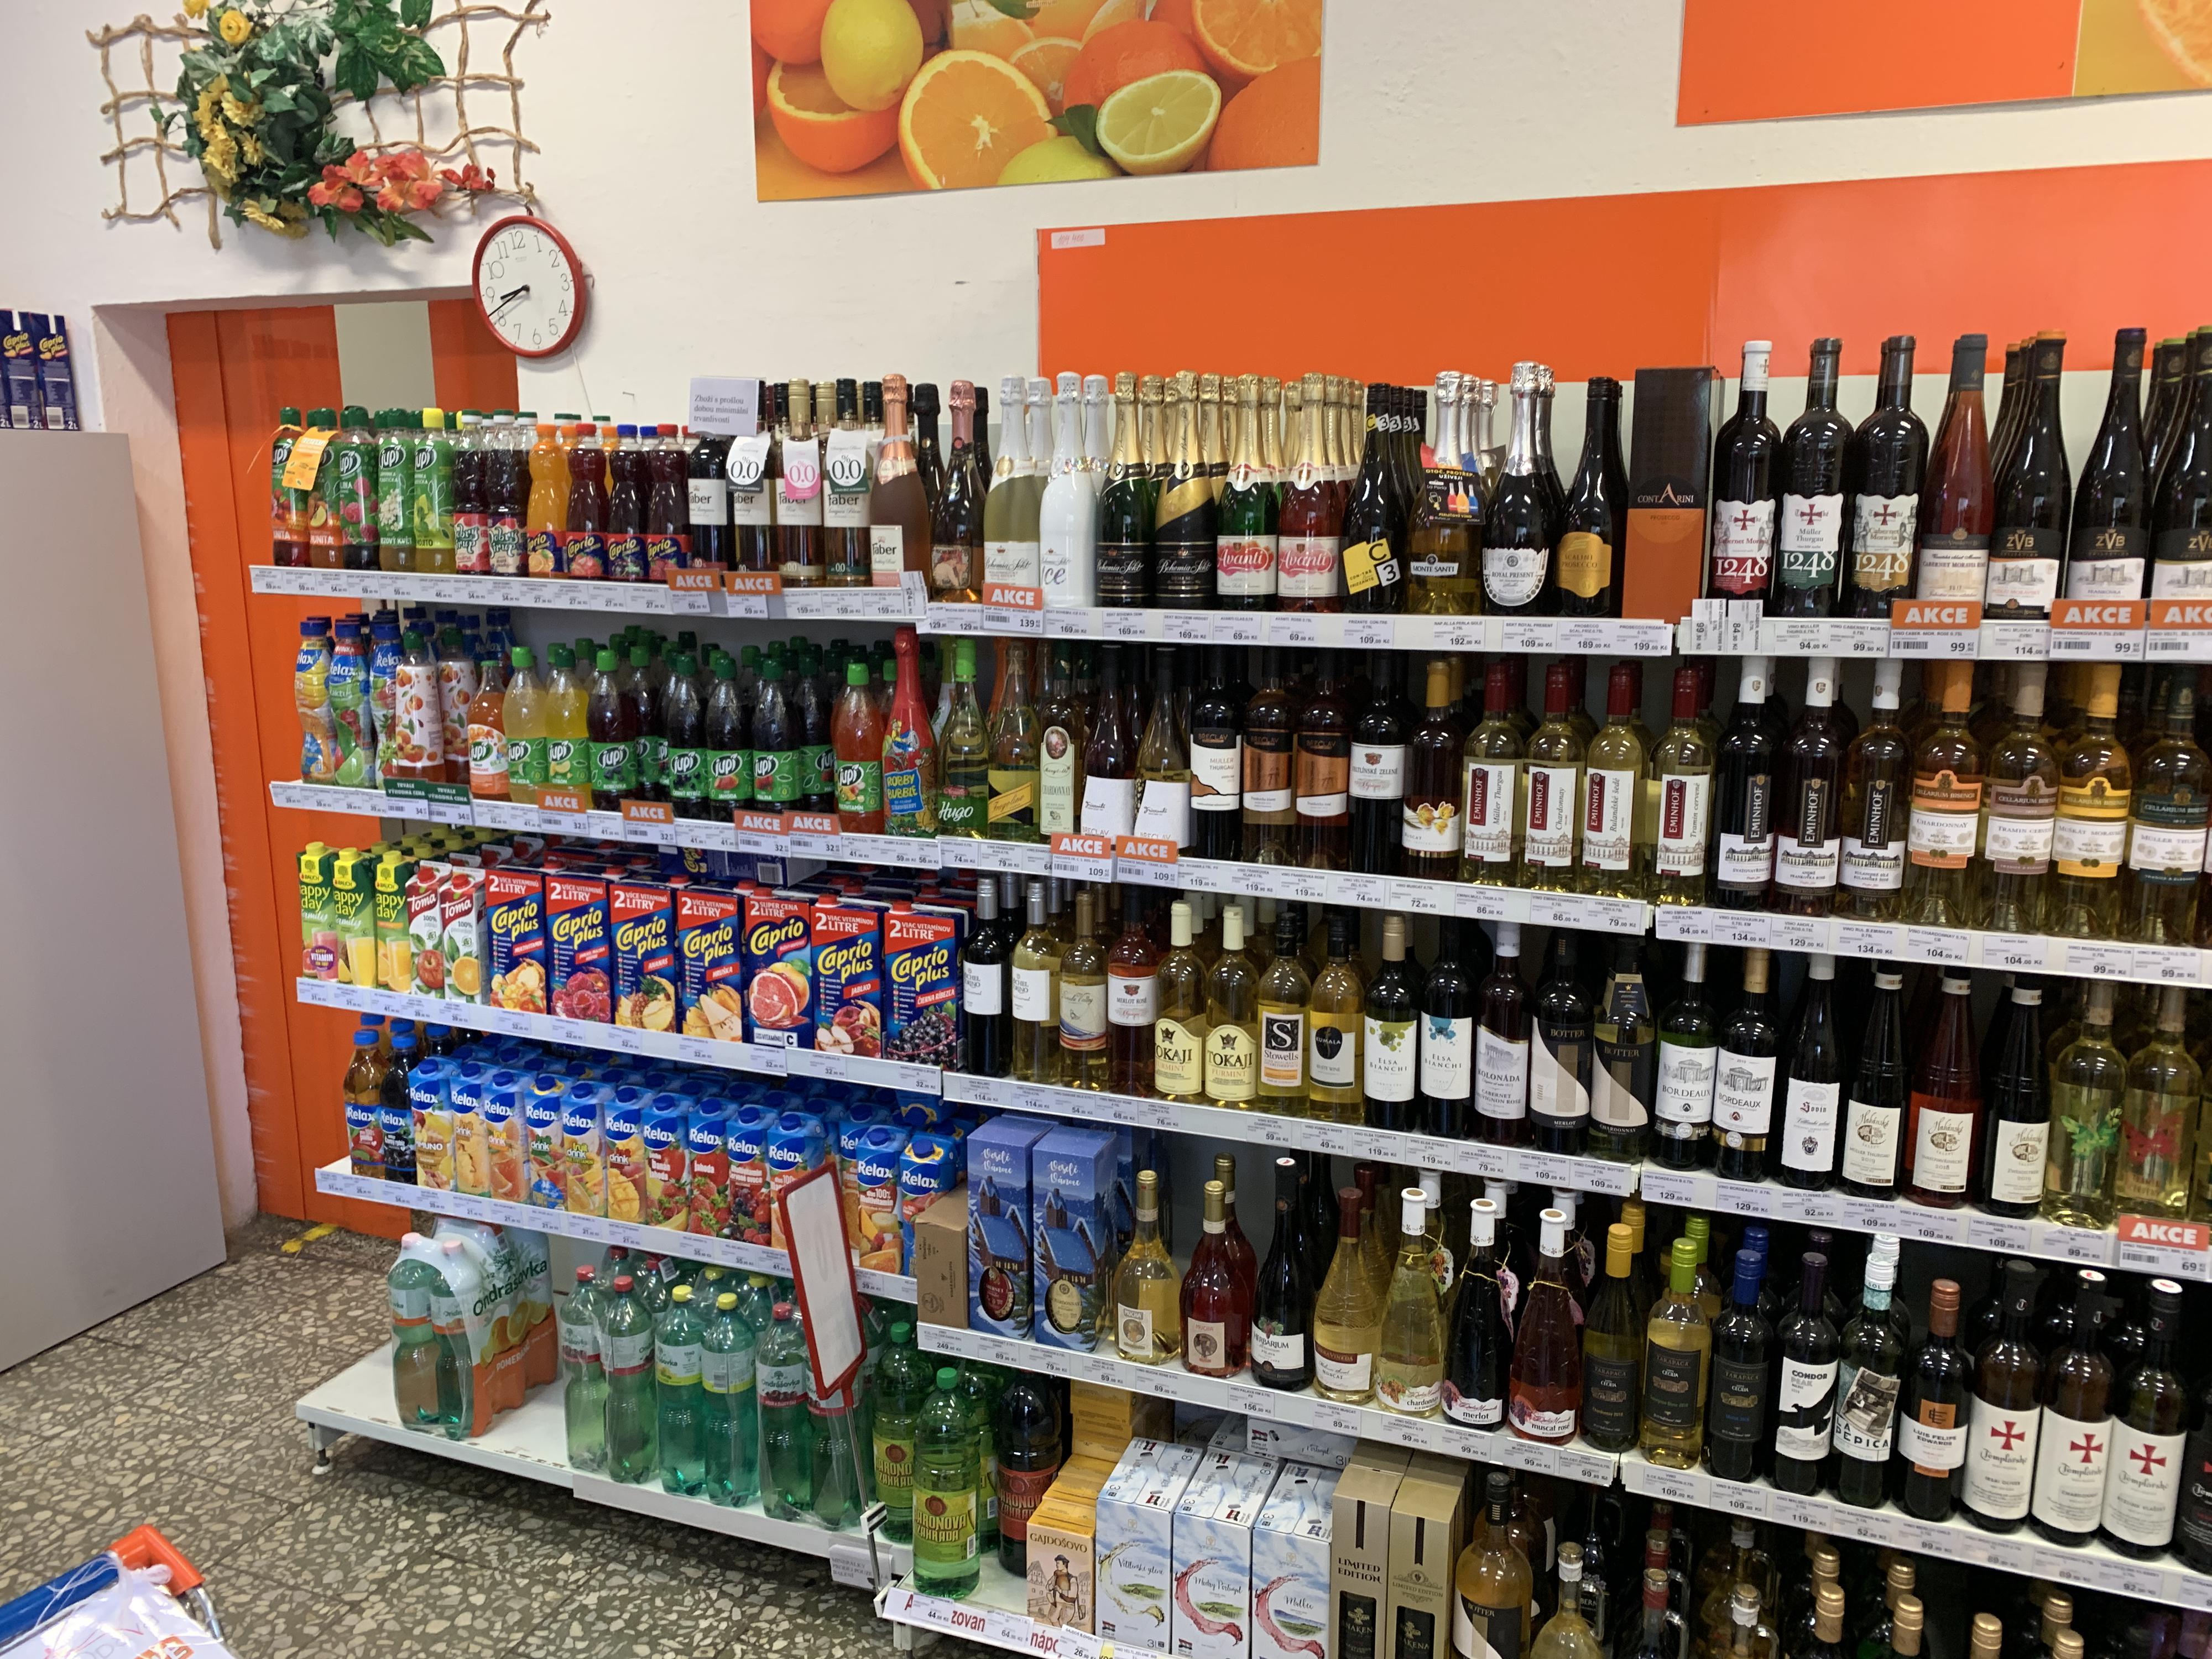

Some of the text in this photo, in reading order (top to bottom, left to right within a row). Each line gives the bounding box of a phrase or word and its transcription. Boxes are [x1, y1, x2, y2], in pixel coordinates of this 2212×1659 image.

[509, 230, 525, 250] 12
[534, 234, 542, 253] 1
[495, 241, 509, 259] 11
[549, 249, 560, 268] 2
[486, 260, 504, 280] 10
[561, 273, 570, 291] 3
[486, 286, 495, 304] 9
[558, 299, 568, 316] 4
[497, 310, 507, 327] 8
[549, 318, 558, 336] 5
[514, 323, 521, 340] 7
[532, 328, 542, 345] 6
[3, 332, 28, 351] Caprio
[694, 394, 713, 403] Zboží
[694, 415, 730, 424] trvanlivosti
[1637, 483, 1694, 505] CONTARINI
[1796, 535, 1824, 544] Thurgau
[1218, 550, 1263, 570] Avanti
[1782, 550, 1835, 578] 1248
[1855, 552, 1909, 581] 1248
[1716, 555, 1768, 584] 1248
[676, 575, 713, 588] AKCE
[734, 577, 773, 591] AKCE
[991, 589, 1034, 606] AKCE
[1020, 618, 1034, 628] 139
[1905, 607, 1968, 624] AKCE
[2063, 607, 2132, 623] AKCE
[1950, 641, 1965, 651] 99
[2115, 643, 2130, 653] 99
[599, 747, 626, 769] jupi
[886, 773, 915, 787] ROBBY
[886, 785, 918, 800] BUBBLE
[1473, 777, 1482, 820] EMINHOF
[544, 795, 578, 810] AKCE
[1555, 787, 1564, 831] Chardonnay
[1669, 788, 1679, 834] EMINHOF
[630, 806, 665, 820] AKCE
[938, 801, 974, 822] Hugo
[1609, 795, 1619, 832] Rulandské
[1750, 785, 1763, 841] EMINHOF
[742, 815, 780, 831] AKCE
[792, 816, 832, 831] AKCE
[1917, 817, 1968, 830] CHARDONNAY
[1059, 837, 1103, 854] AKCE
[1124, 841, 1168, 858] AKCE
[1088, 867, 1103, 877] 109
[489, 875, 539, 892] 2 VÍCE VITAMINŮ
[500, 883, 526, 895] LITRY
[301, 899, 322, 912] day
[408, 893, 437, 911] Toma
[441, 899, 472, 918] Toma
[750, 901, 760, 916] 2
[781, 903, 798, 911] CENA
[491, 900, 538, 933] Caprio
[760, 907, 785, 918] LITRE
[512, 917, 539, 942] plus
[615, 916, 667, 951] Caprio
[750, 918, 804, 956] Caprio
[890, 920, 951, 937] 2 VIAC VITAMÍNOV
[902, 927, 935, 940] LITRE
[311, 953, 333, 962] VITAMIN
[648, 960, 669, 970] ANANAS
[817, 939, 873, 975] Caprio
[891, 946, 949, 982] Caprio
[841, 959, 873, 984] plus
[915, 967, 950, 992] plus
[851, 983, 872, 995] JABLKO
[786, 1034, 794, 1046] C
[1550, 1027, 1585, 1039] BOTTER
[1207, 1051, 1254, 1068] TOKAJI
[1264, 1050, 1298, 1062] Stowells
[1369, 1063, 1407, 1072] BIANCHI
[410, 1087, 438, 1104] Relax
[1662, 1084, 1711, 1098] BORDEAUX
[452, 1092, 479, 1108] Relax
[1718, 1092, 1761, 1109] BORDEAUX
[347, 1107, 374, 1122] Relax
[526, 1106, 557, 1121] Relax
[567, 1150, 586, 1159] drink
[2131, 1222, 2198, 1245] AKCE
[2182, 1262, 2197, 1272] 69
[472, 1259, 547, 1317] Ondrášovka
[495, 1343, 531, 1371] POMERANČ
[1792, 1370, 1828, 1380] CONDOR
[1463, 1410, 1489, 1421] merlot
[1531, 1422, 1570, 1433] muscat rosé
[1913, 1428, 1957, 1442] LUIS FELIPE
[1917, 1435, 1953, 1447] EDWARDS
[915, 1526, 959, 1542] ZAHRADA
[1030, 1532, 1087, 1554] GAJDOŠOVO
[1338, 1557, 1381, 1573] LIMITED
[1337, 1567, 1381, 1584] EDITION
